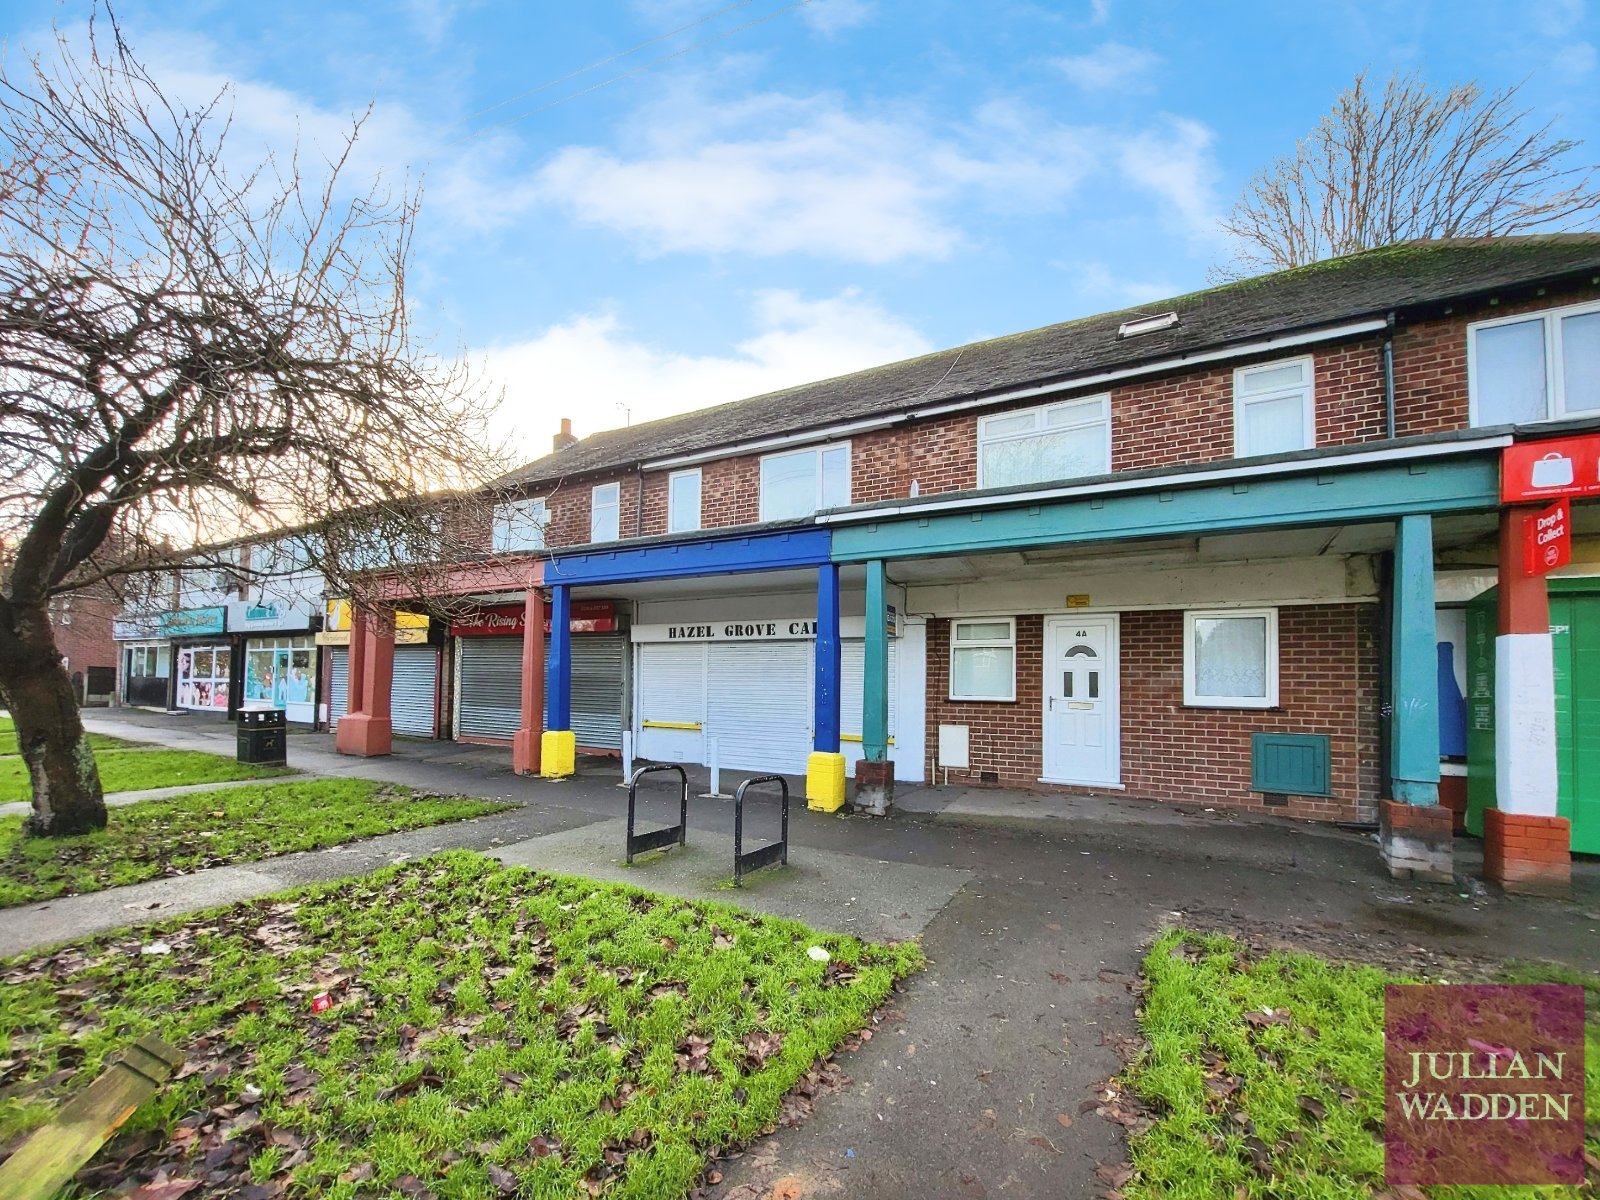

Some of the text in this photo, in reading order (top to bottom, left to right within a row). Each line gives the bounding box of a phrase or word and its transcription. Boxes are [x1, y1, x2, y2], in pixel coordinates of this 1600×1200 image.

[1537, 507, 1564, 531] Drop &
[1537, 525, 1564, 545] Collect
[485, 612, 518, 629] Rising
[669, 625, 715, 639] HAZEL
[725, 623, 776, 637] GROVE
[1075, 630, 1087, 638] 4A
